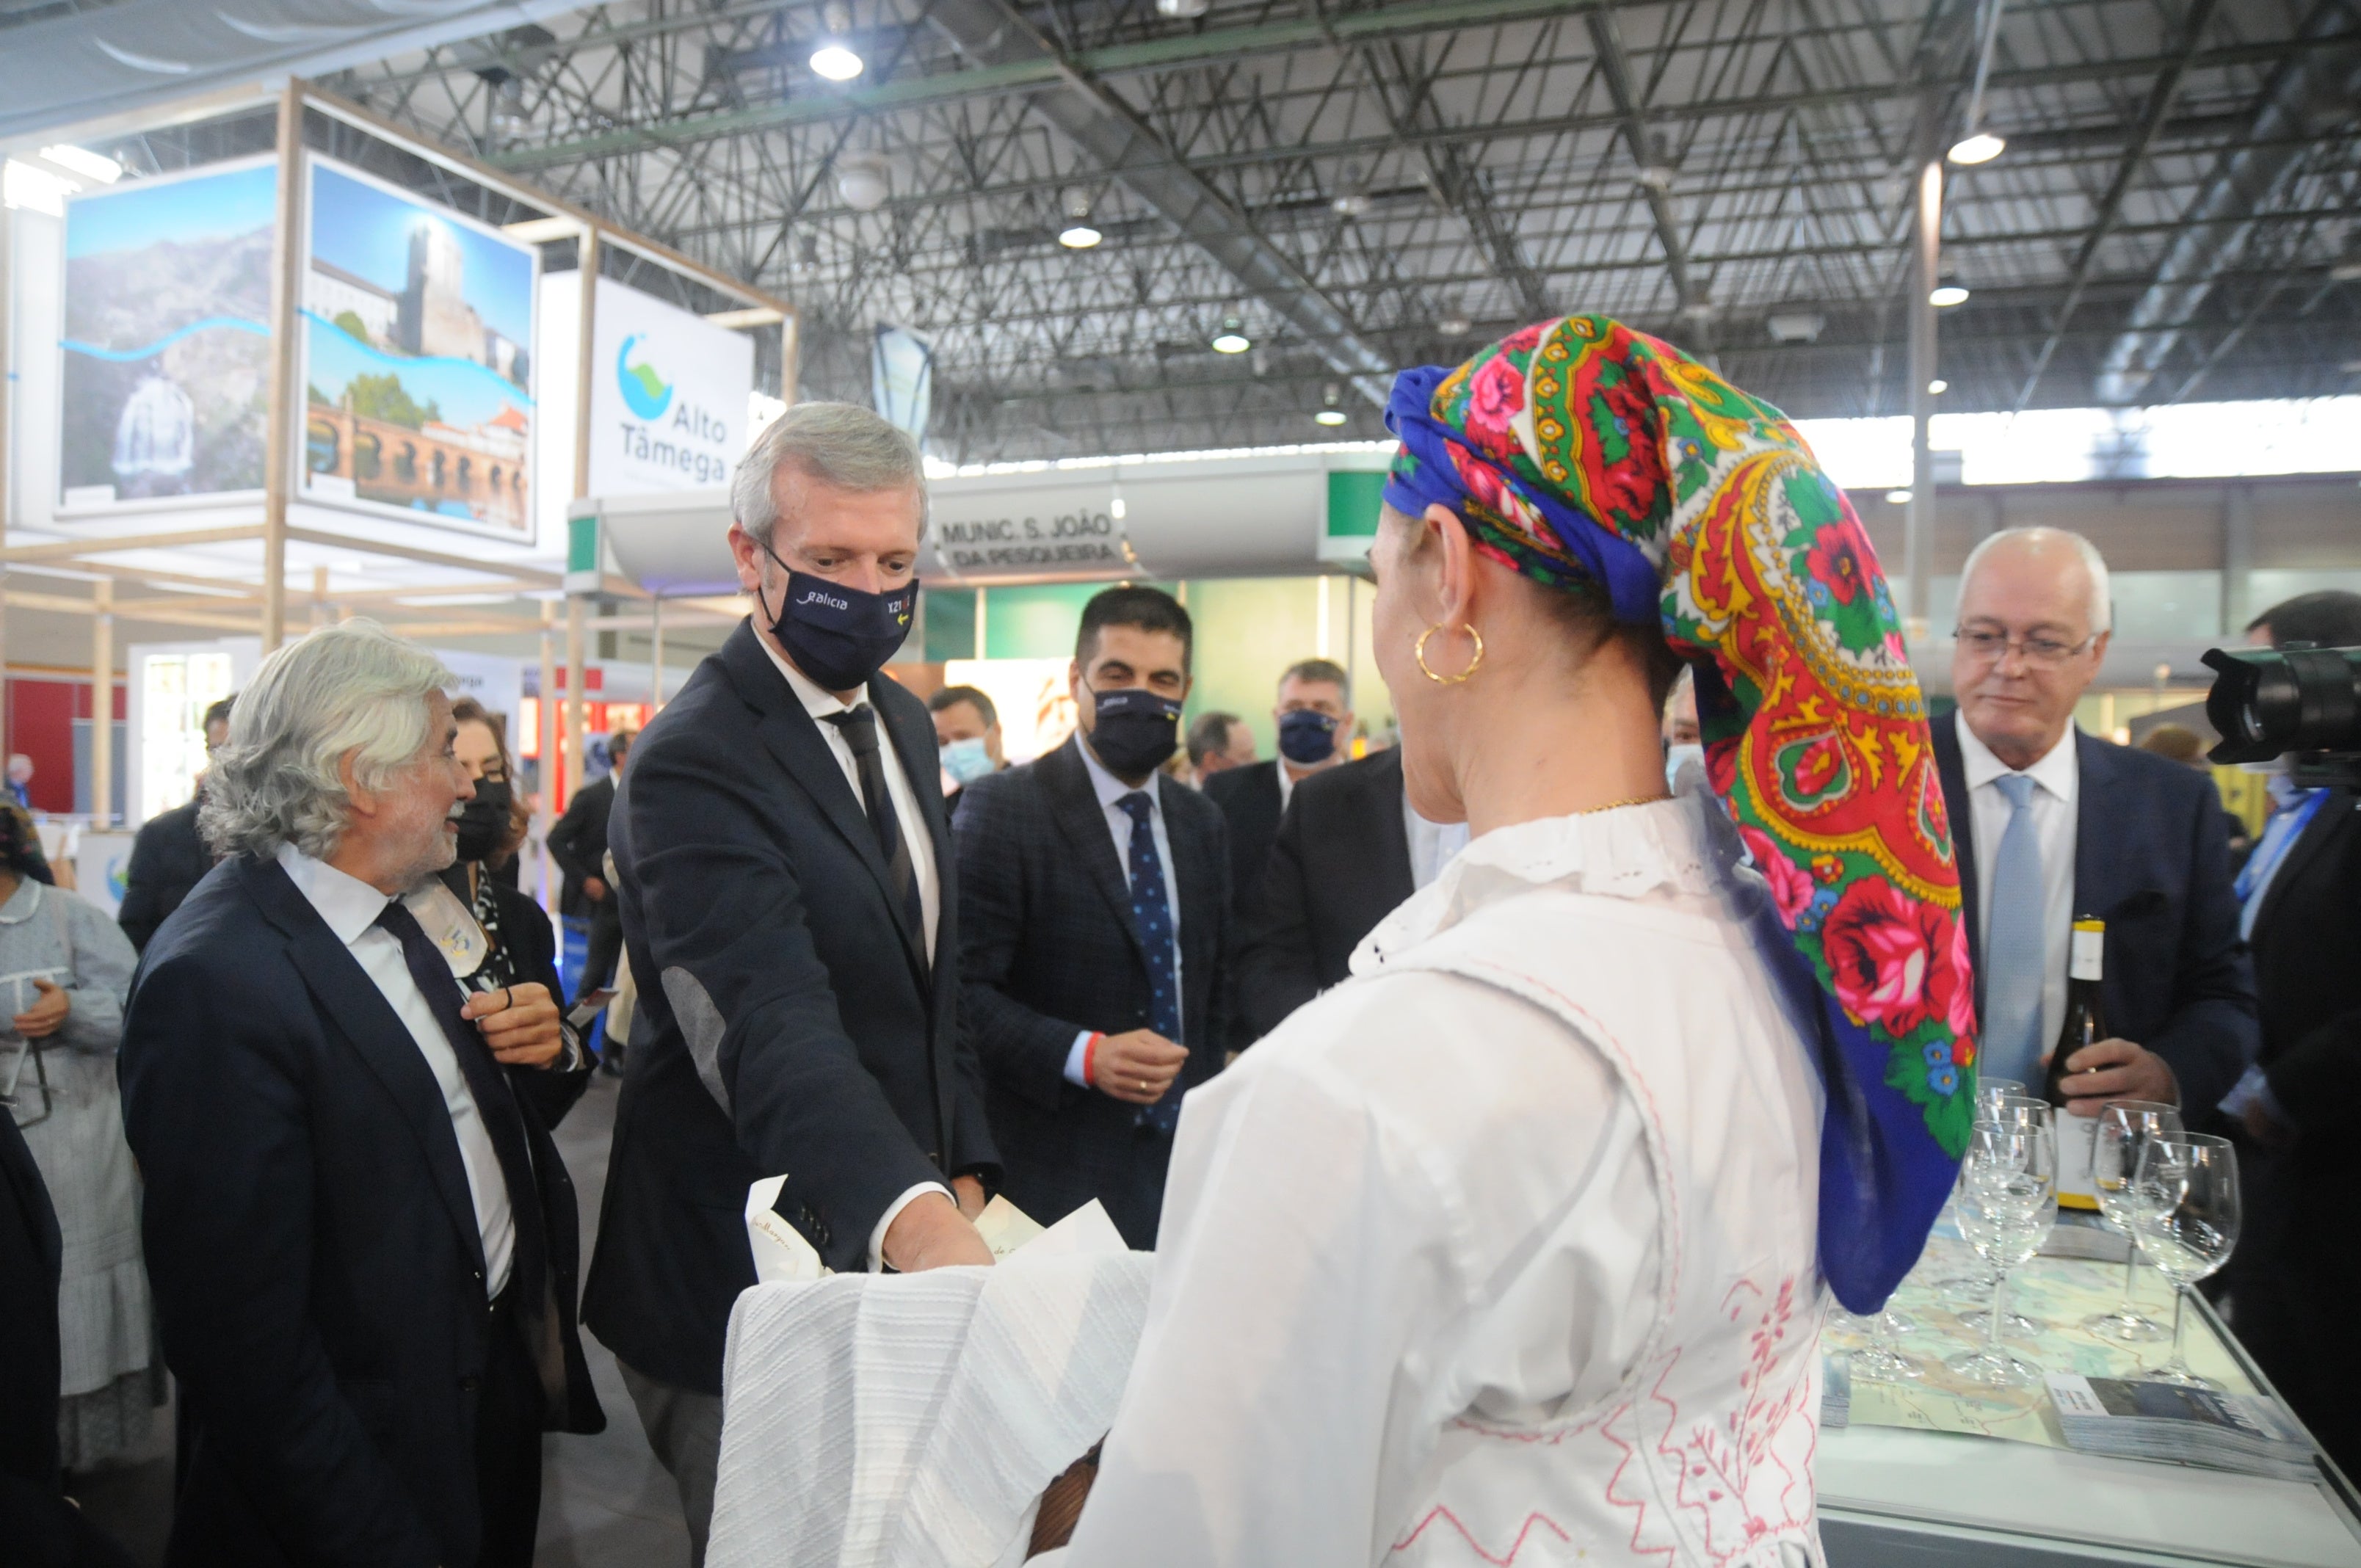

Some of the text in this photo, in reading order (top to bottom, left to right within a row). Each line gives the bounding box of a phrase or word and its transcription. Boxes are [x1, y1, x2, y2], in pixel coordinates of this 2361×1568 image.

[672, 402, 726, 443] Alto
[620, 420, 725, 483] Tâmega
[942, 507, 1111, 542] MUNIC. S. JOÃO
[954, 543, 1116, 567] DA PESQUEIRA
[797, 591, 848, 611] galicia
